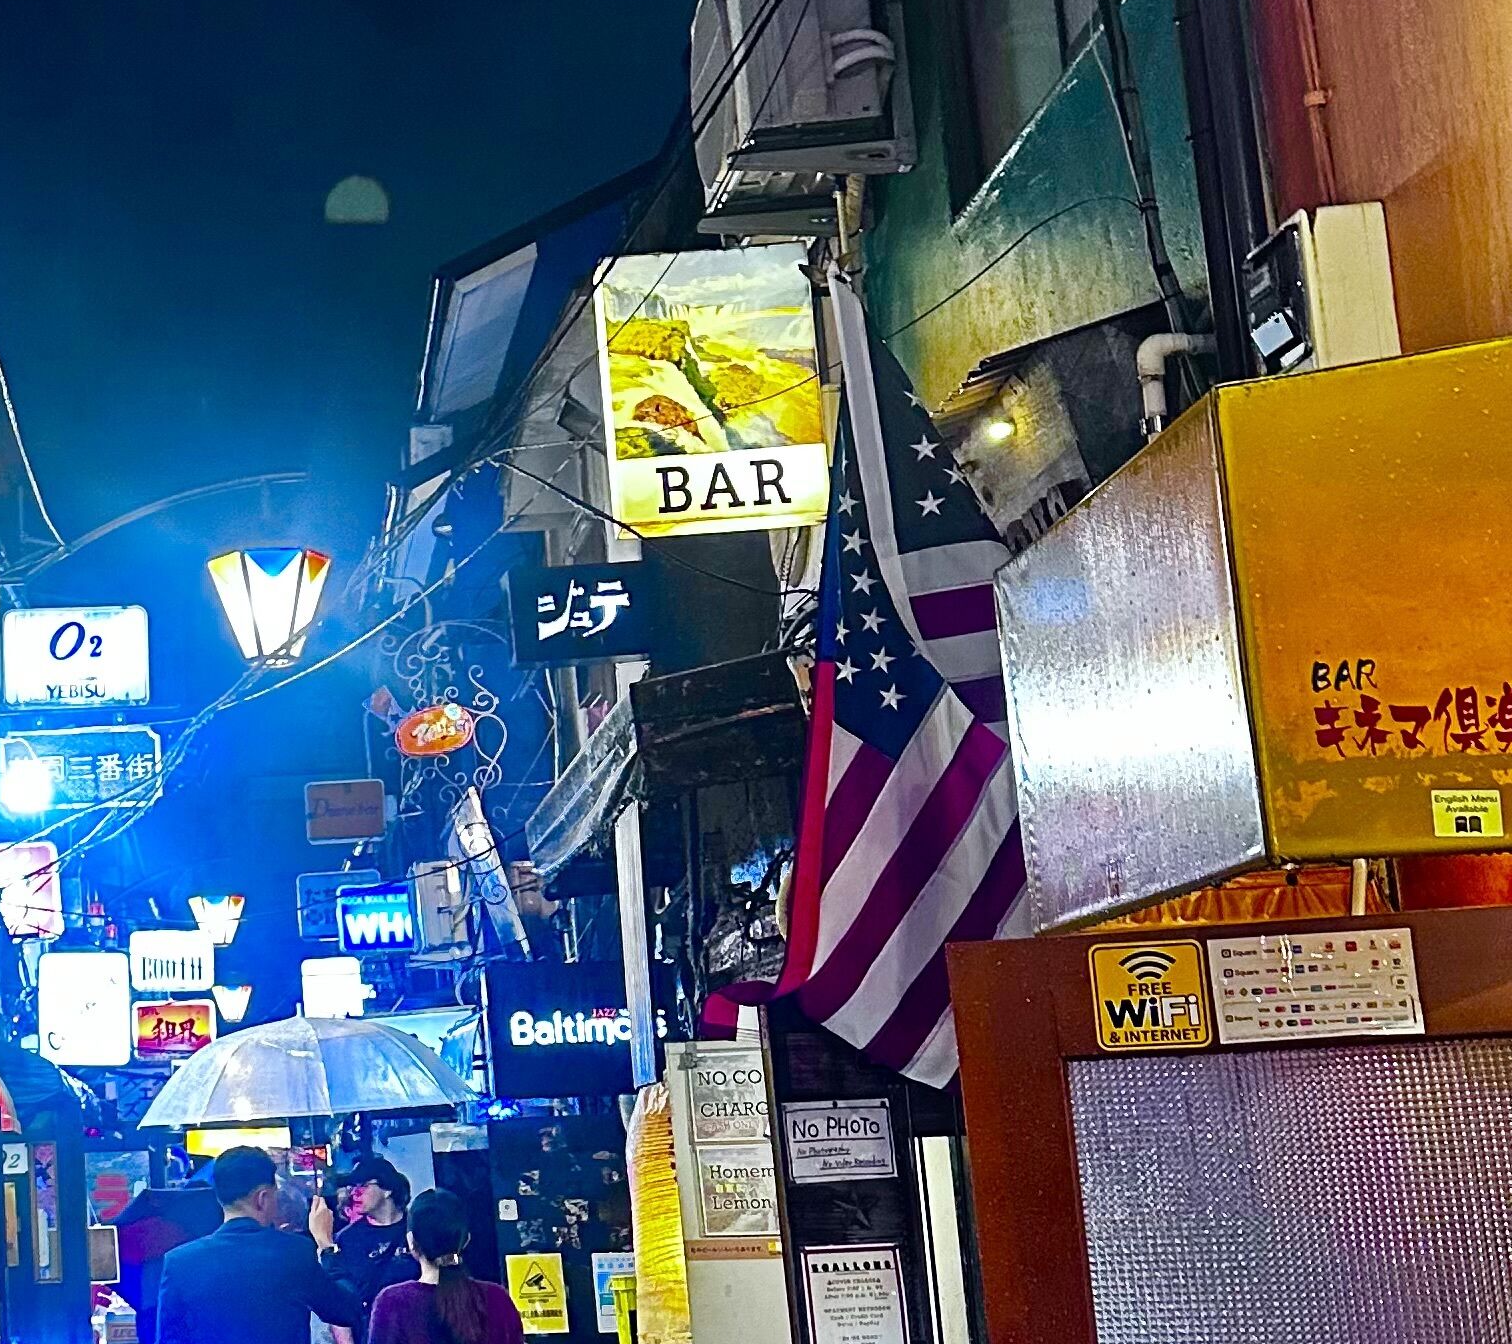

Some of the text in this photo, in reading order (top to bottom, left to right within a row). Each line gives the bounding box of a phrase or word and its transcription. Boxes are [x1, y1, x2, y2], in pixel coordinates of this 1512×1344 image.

[656, 459, 792, 515] BAR
[1311, 658, 1377, 693] BAR
[45, 683, 107, 700] YEBISU
[1434, 794, 1498, 806] English Menu
[1445, 805, 1488, 814] Available
[1128, 982, 1173, 996] FREE
[1104, 993, 1201, 1029] WiFi
[1109, 1028, 1200, 1044] & INTERNET
[698, 1069, 763, 1087] NO CO
[712, 1196, 773, 1210] Lemon
